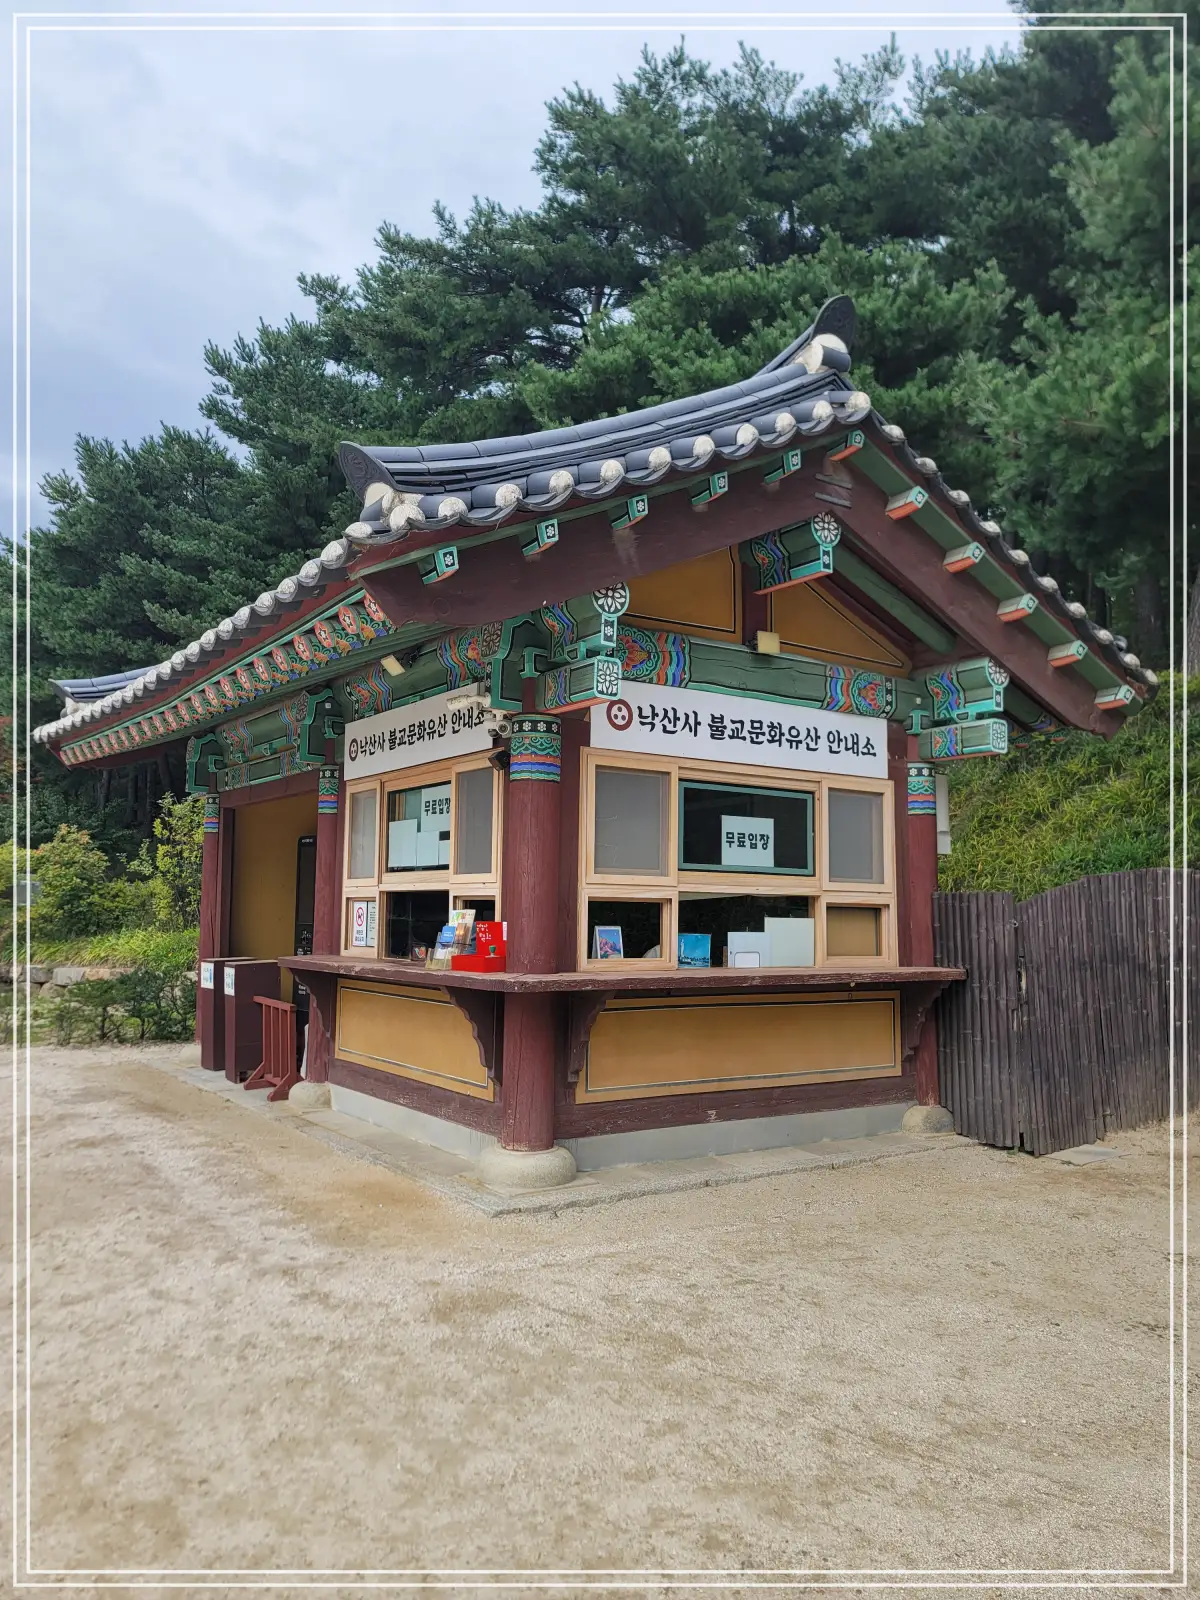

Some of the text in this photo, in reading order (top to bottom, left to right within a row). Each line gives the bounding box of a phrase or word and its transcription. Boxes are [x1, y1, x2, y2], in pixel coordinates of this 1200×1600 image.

[359, 706, 485, 758] 낙산사 불교문화유산 안내소
[637, 704, 877, 758] 낙산사 불교문화유산 안내소
[424, 797, 451, 816] 무료입장
[725, 831, 770, 850] 무료입장
